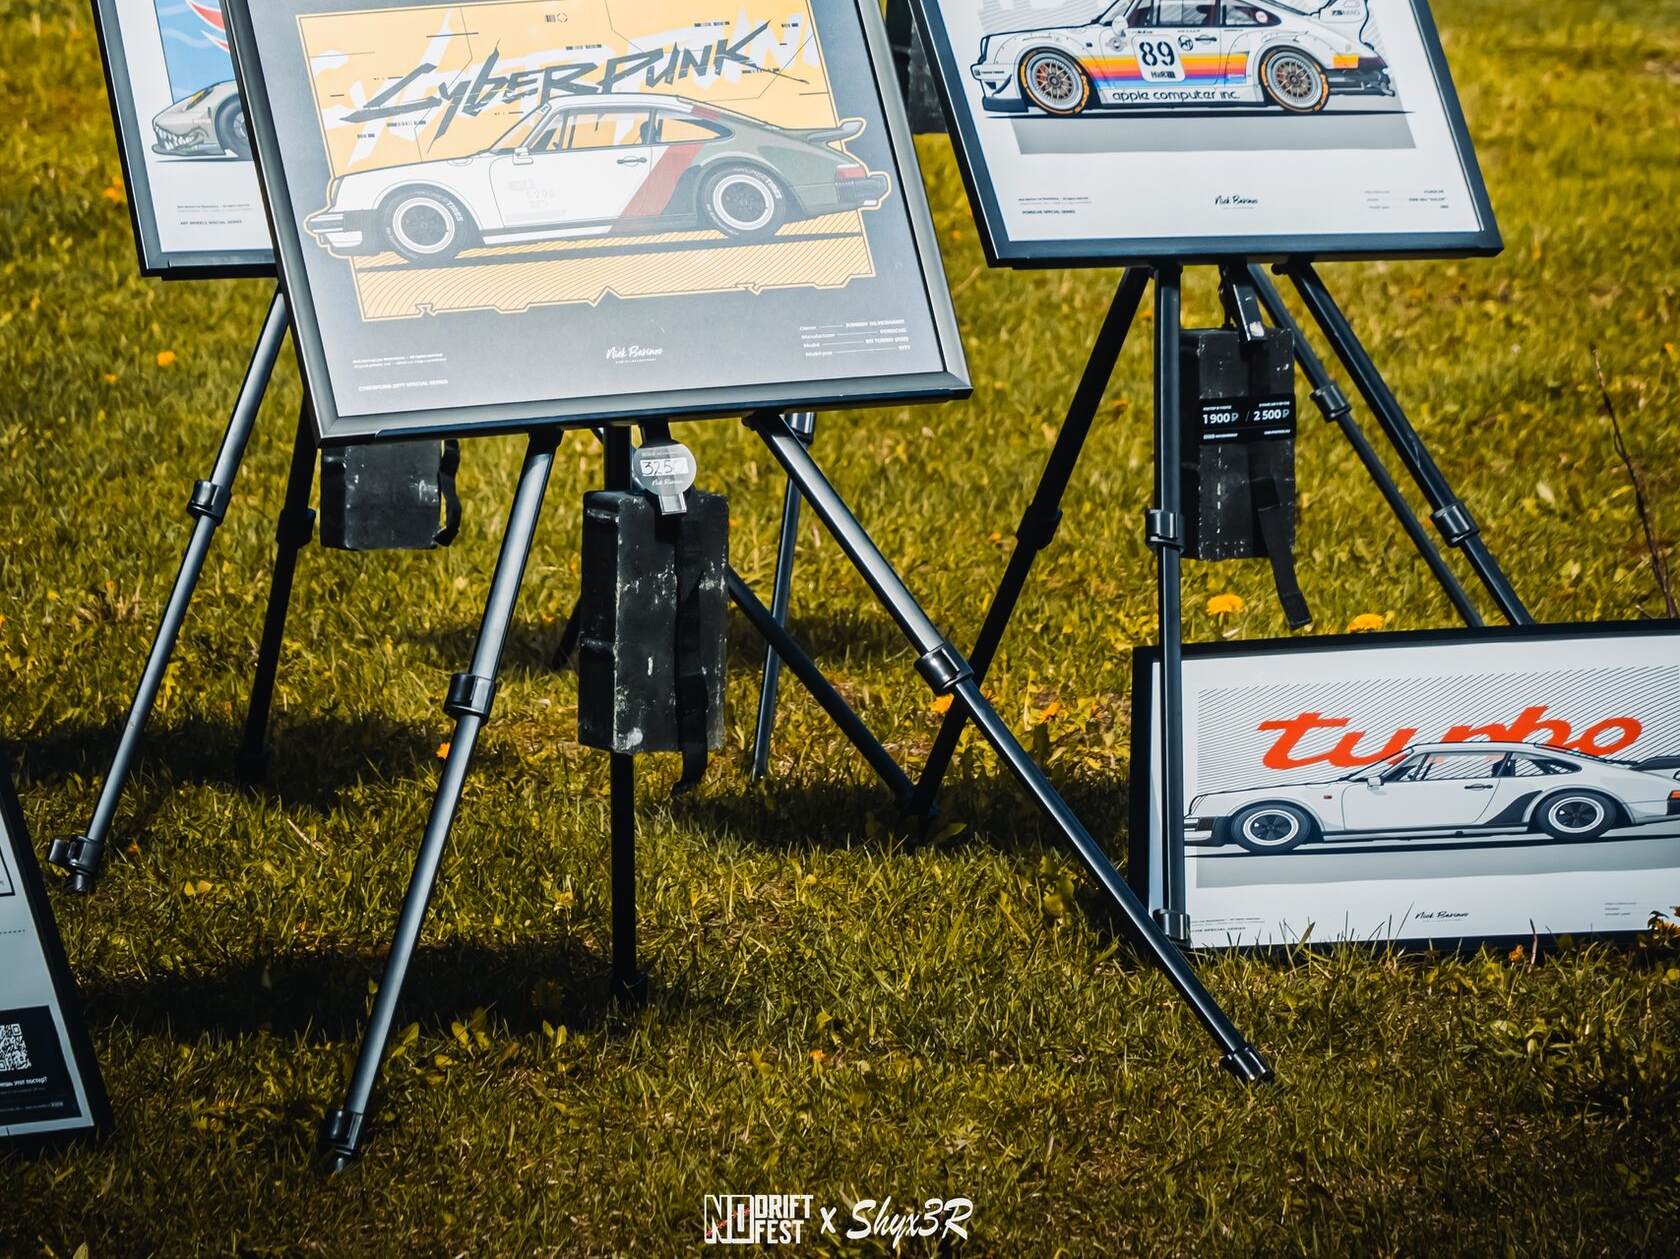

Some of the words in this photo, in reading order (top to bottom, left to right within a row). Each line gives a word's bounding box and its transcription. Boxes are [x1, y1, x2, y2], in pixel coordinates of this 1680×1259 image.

[1139, 41, 1175, 67] 89
[1112, 91, 1149, 102] apple
[1153, 91, 1215, 102] computer
[1220, 90, 1241, 100] inc.
